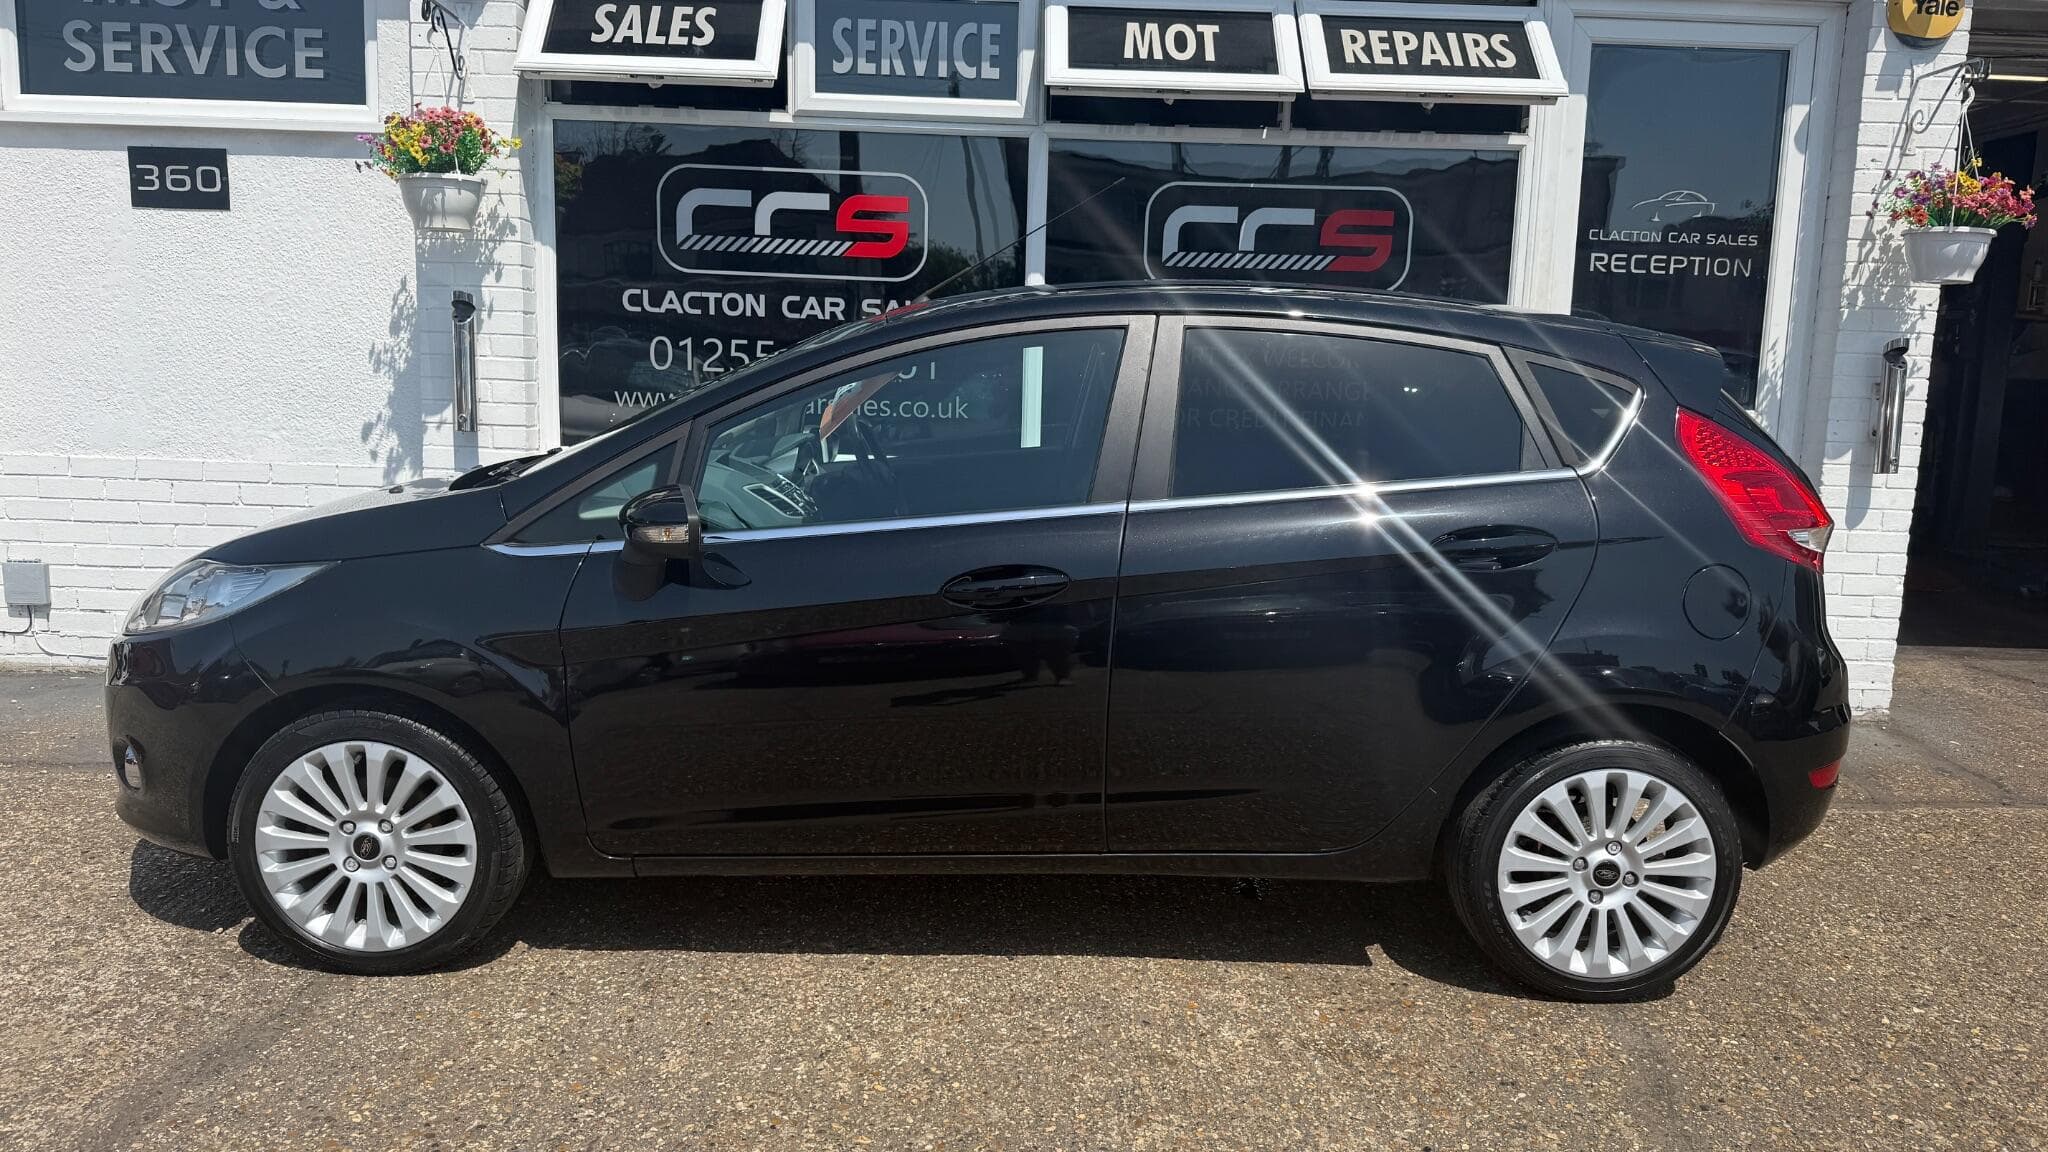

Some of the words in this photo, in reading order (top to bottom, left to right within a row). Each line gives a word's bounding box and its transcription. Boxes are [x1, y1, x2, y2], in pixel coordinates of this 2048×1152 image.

[591, 4, 716, 46] SALES
[1912, 0, 1959, 16] Yale
[62, 19, 324, 78] SERVICE
[832, 17, 1000, 79] SERVICE
[1123, 23, 1220, 61] MOT
[1340, 29, 1516, 68] REPAIRS
[135, 164, 222, 192] 360
[1588, 229, 1662, 243] CLACTON
[1668, 232, 1700, 244] CAR
[1706, 233, 1758, 246] SALES
[1589, 252, 1752, 278] RECEPTION
[622, 288, 766, 318] CLACTON
[781, 295, 845, 321] CAR
[861, 298, 911, 318] SA
